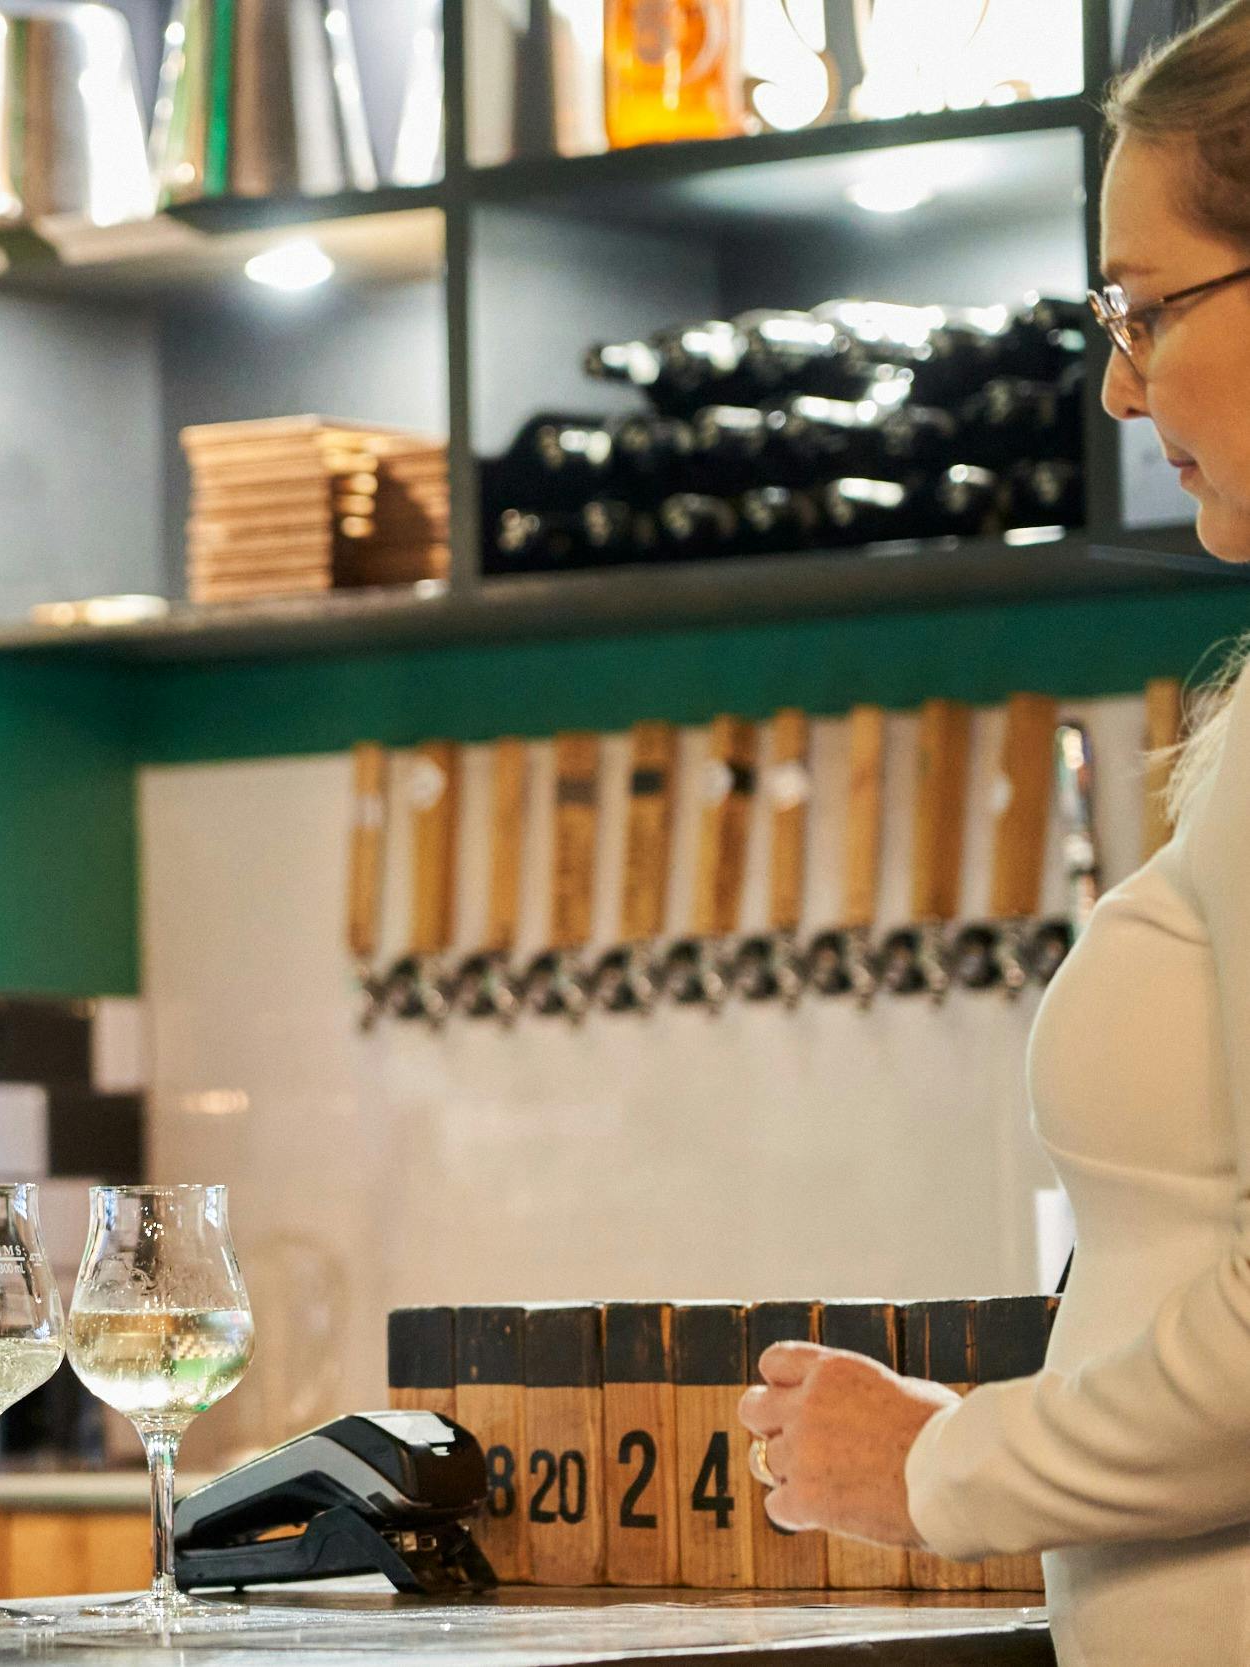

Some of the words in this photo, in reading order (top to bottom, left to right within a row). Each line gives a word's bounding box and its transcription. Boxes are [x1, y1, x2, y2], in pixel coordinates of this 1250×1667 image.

[529, 1450, 587, 1524] 20
[618, 1430, 657, 1529] 2
[692, 1431, 735, 1529] 4
